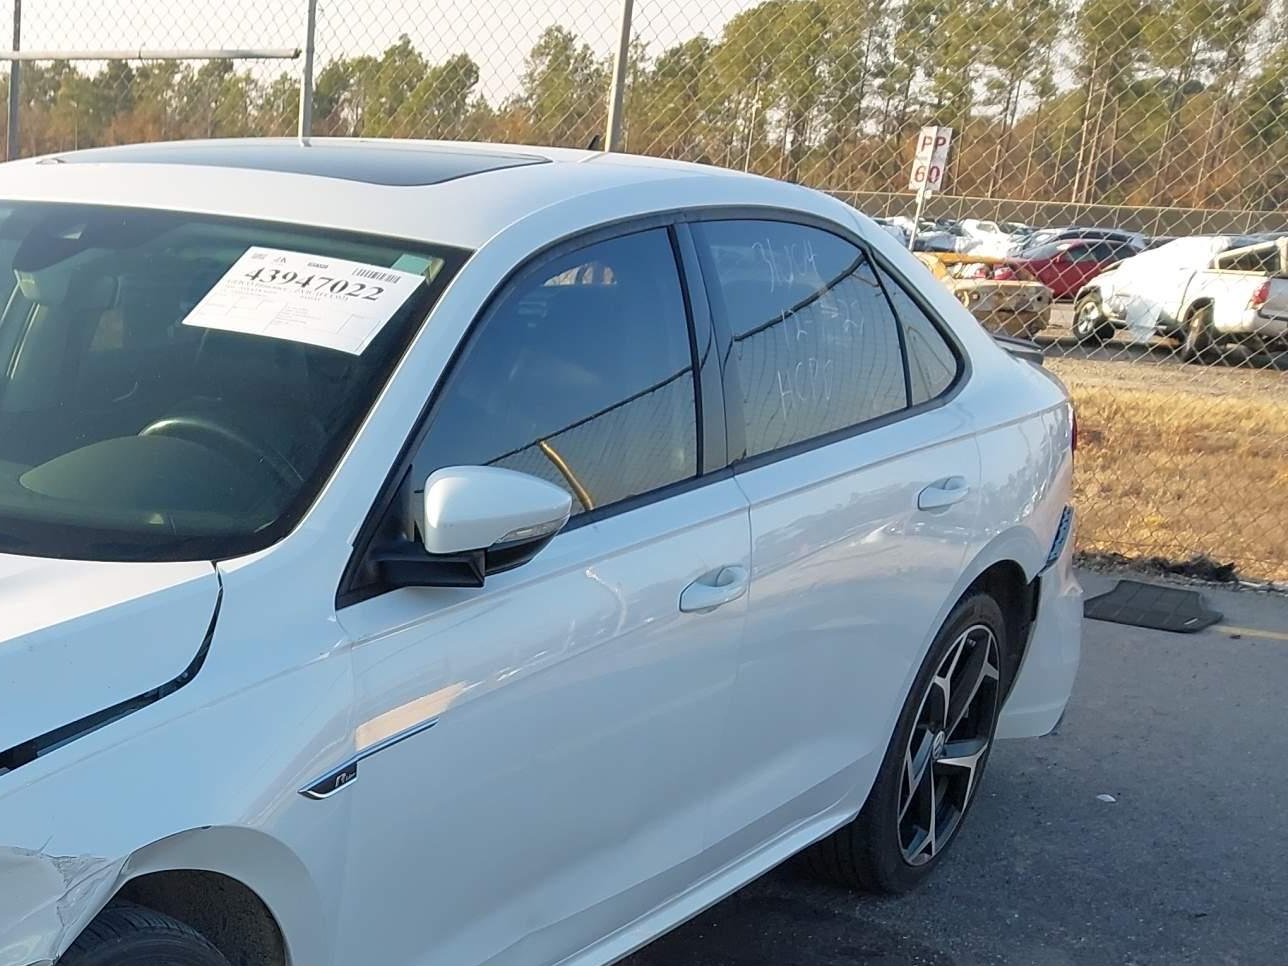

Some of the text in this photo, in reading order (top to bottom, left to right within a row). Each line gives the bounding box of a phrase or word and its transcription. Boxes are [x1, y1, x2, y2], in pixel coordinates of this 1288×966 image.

[921, 135, 946, 152] PP
[915, 165, 940, 184] 60
[246, 267, 385, 300] 43947022
